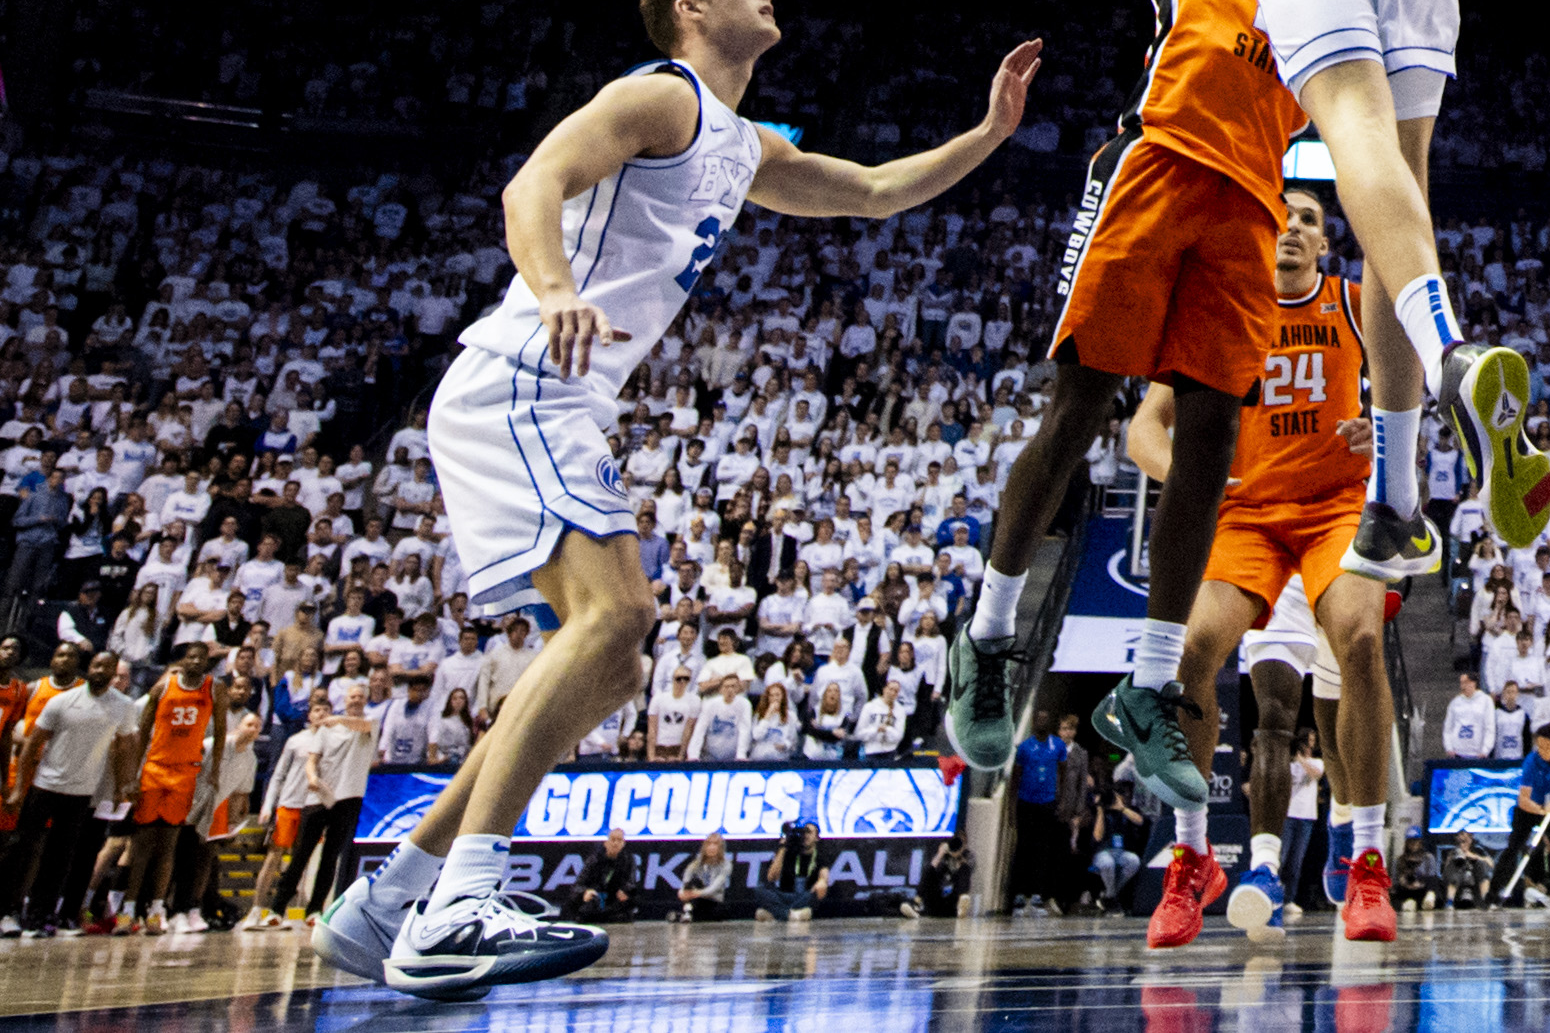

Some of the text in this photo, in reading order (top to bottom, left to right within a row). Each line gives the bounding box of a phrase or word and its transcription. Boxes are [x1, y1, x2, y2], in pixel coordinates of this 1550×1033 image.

[688, 154, 755, 210] BY
[1057, 179, 1103, 296] COWBOYS
[1271, 324, 1341, 349] AHOMA
[1264, 352, 1327, 406] 24
[1270, 410, 1320, 437] STATE
[170, 706, 198, 726] 33
[525, 770, 804, 836] GO COUGS
[505, 848, 924, 892] BAKTAL
